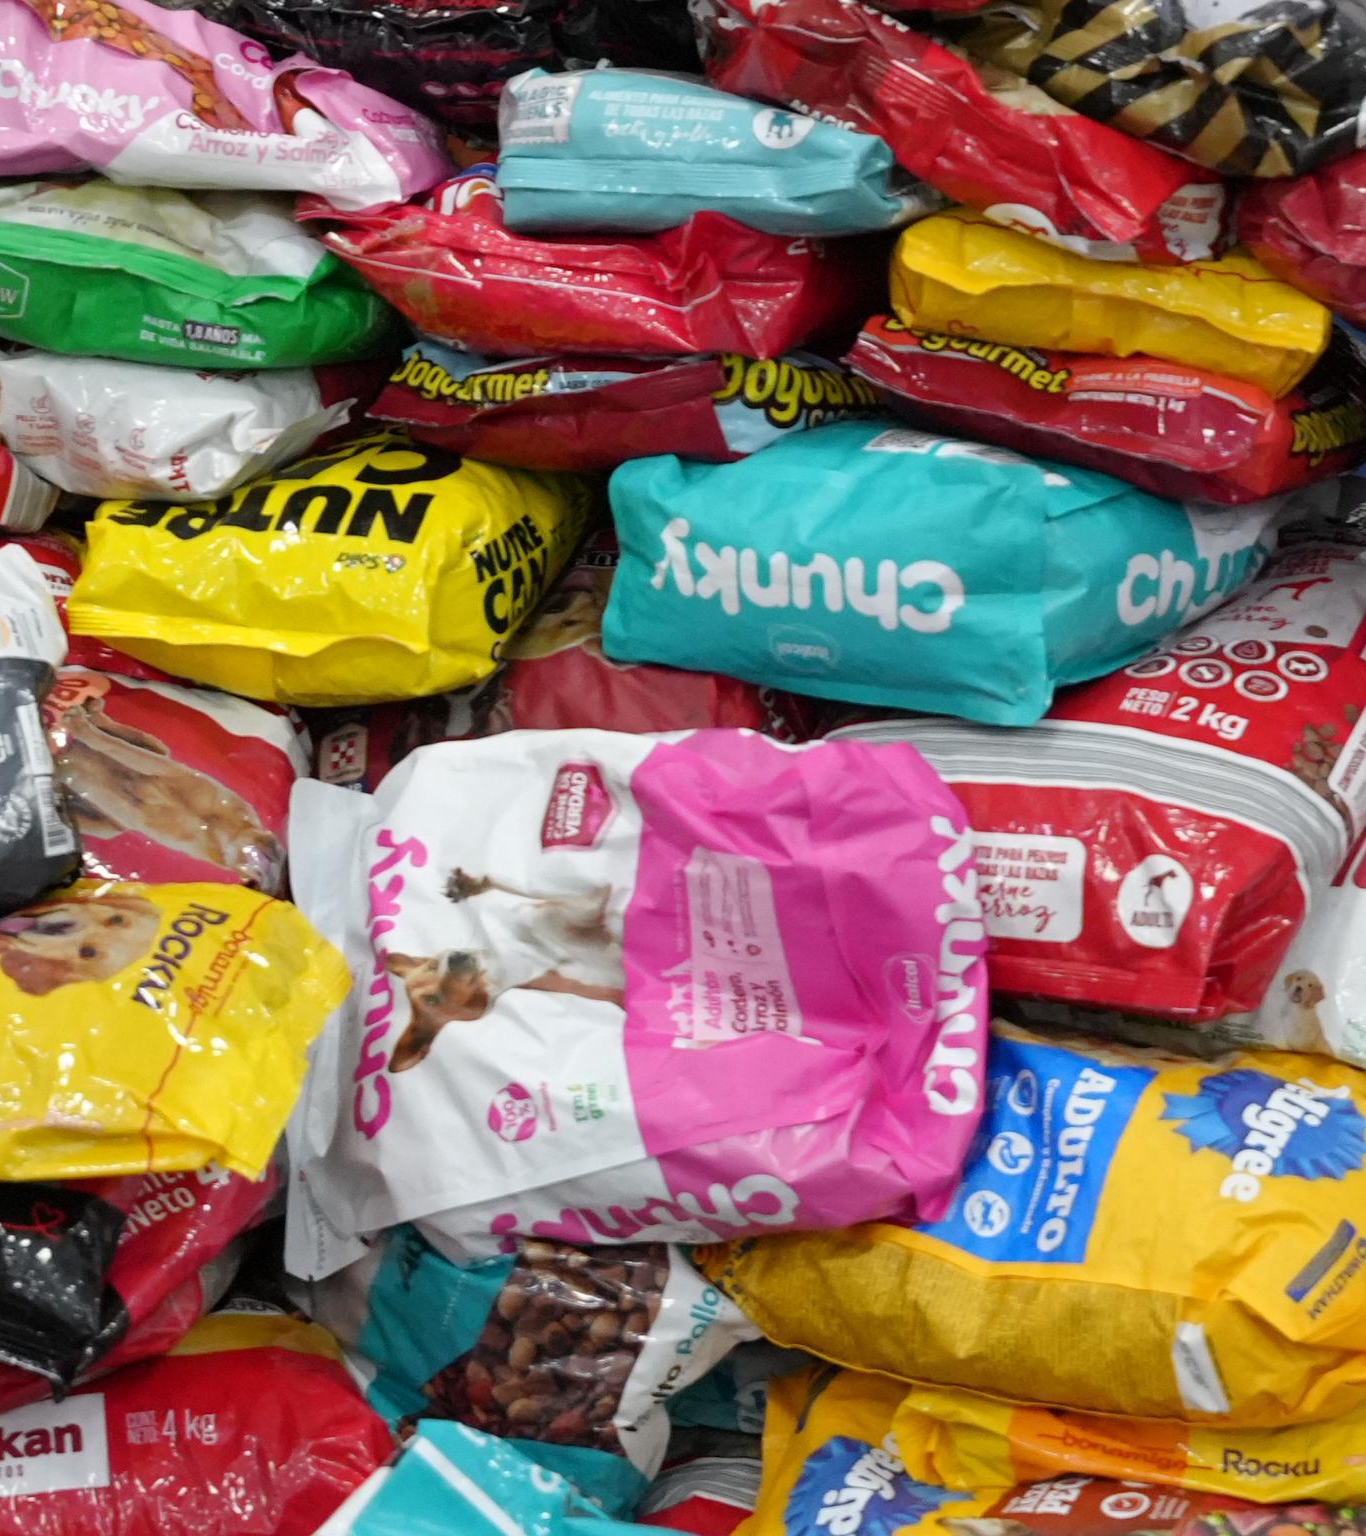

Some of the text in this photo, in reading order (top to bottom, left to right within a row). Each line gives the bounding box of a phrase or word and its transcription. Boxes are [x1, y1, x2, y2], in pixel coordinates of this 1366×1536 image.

[188, 133, 248, 156] Arroz
[257, 144, 269, 164] y
[883, 314, 1070, 396] gourmet
[469, 514, 545, 584] NUTRE
[651, 517, 966, 634] Chunky
[1119, 695, 1250, 741] NETO 2 kg
[1126, 686, 1172, 705] PESO
[564, 770, 589, 839] VERDAD
[979, 884, 1035, 902] arne
[352, 827, 428, 1141] Chunky
[703, 970, 722, 1030] Adultos
[926, 814, 986, 1117] Chunky
[766, 979, 789, 1033] almón
[1037, 1066, 1117, 1253] ADULTO
[676, 1285, 720, 1357] Pollo
[161, 1409, 178, 1440] 4
[183, 1407, 220, 1446] kg
